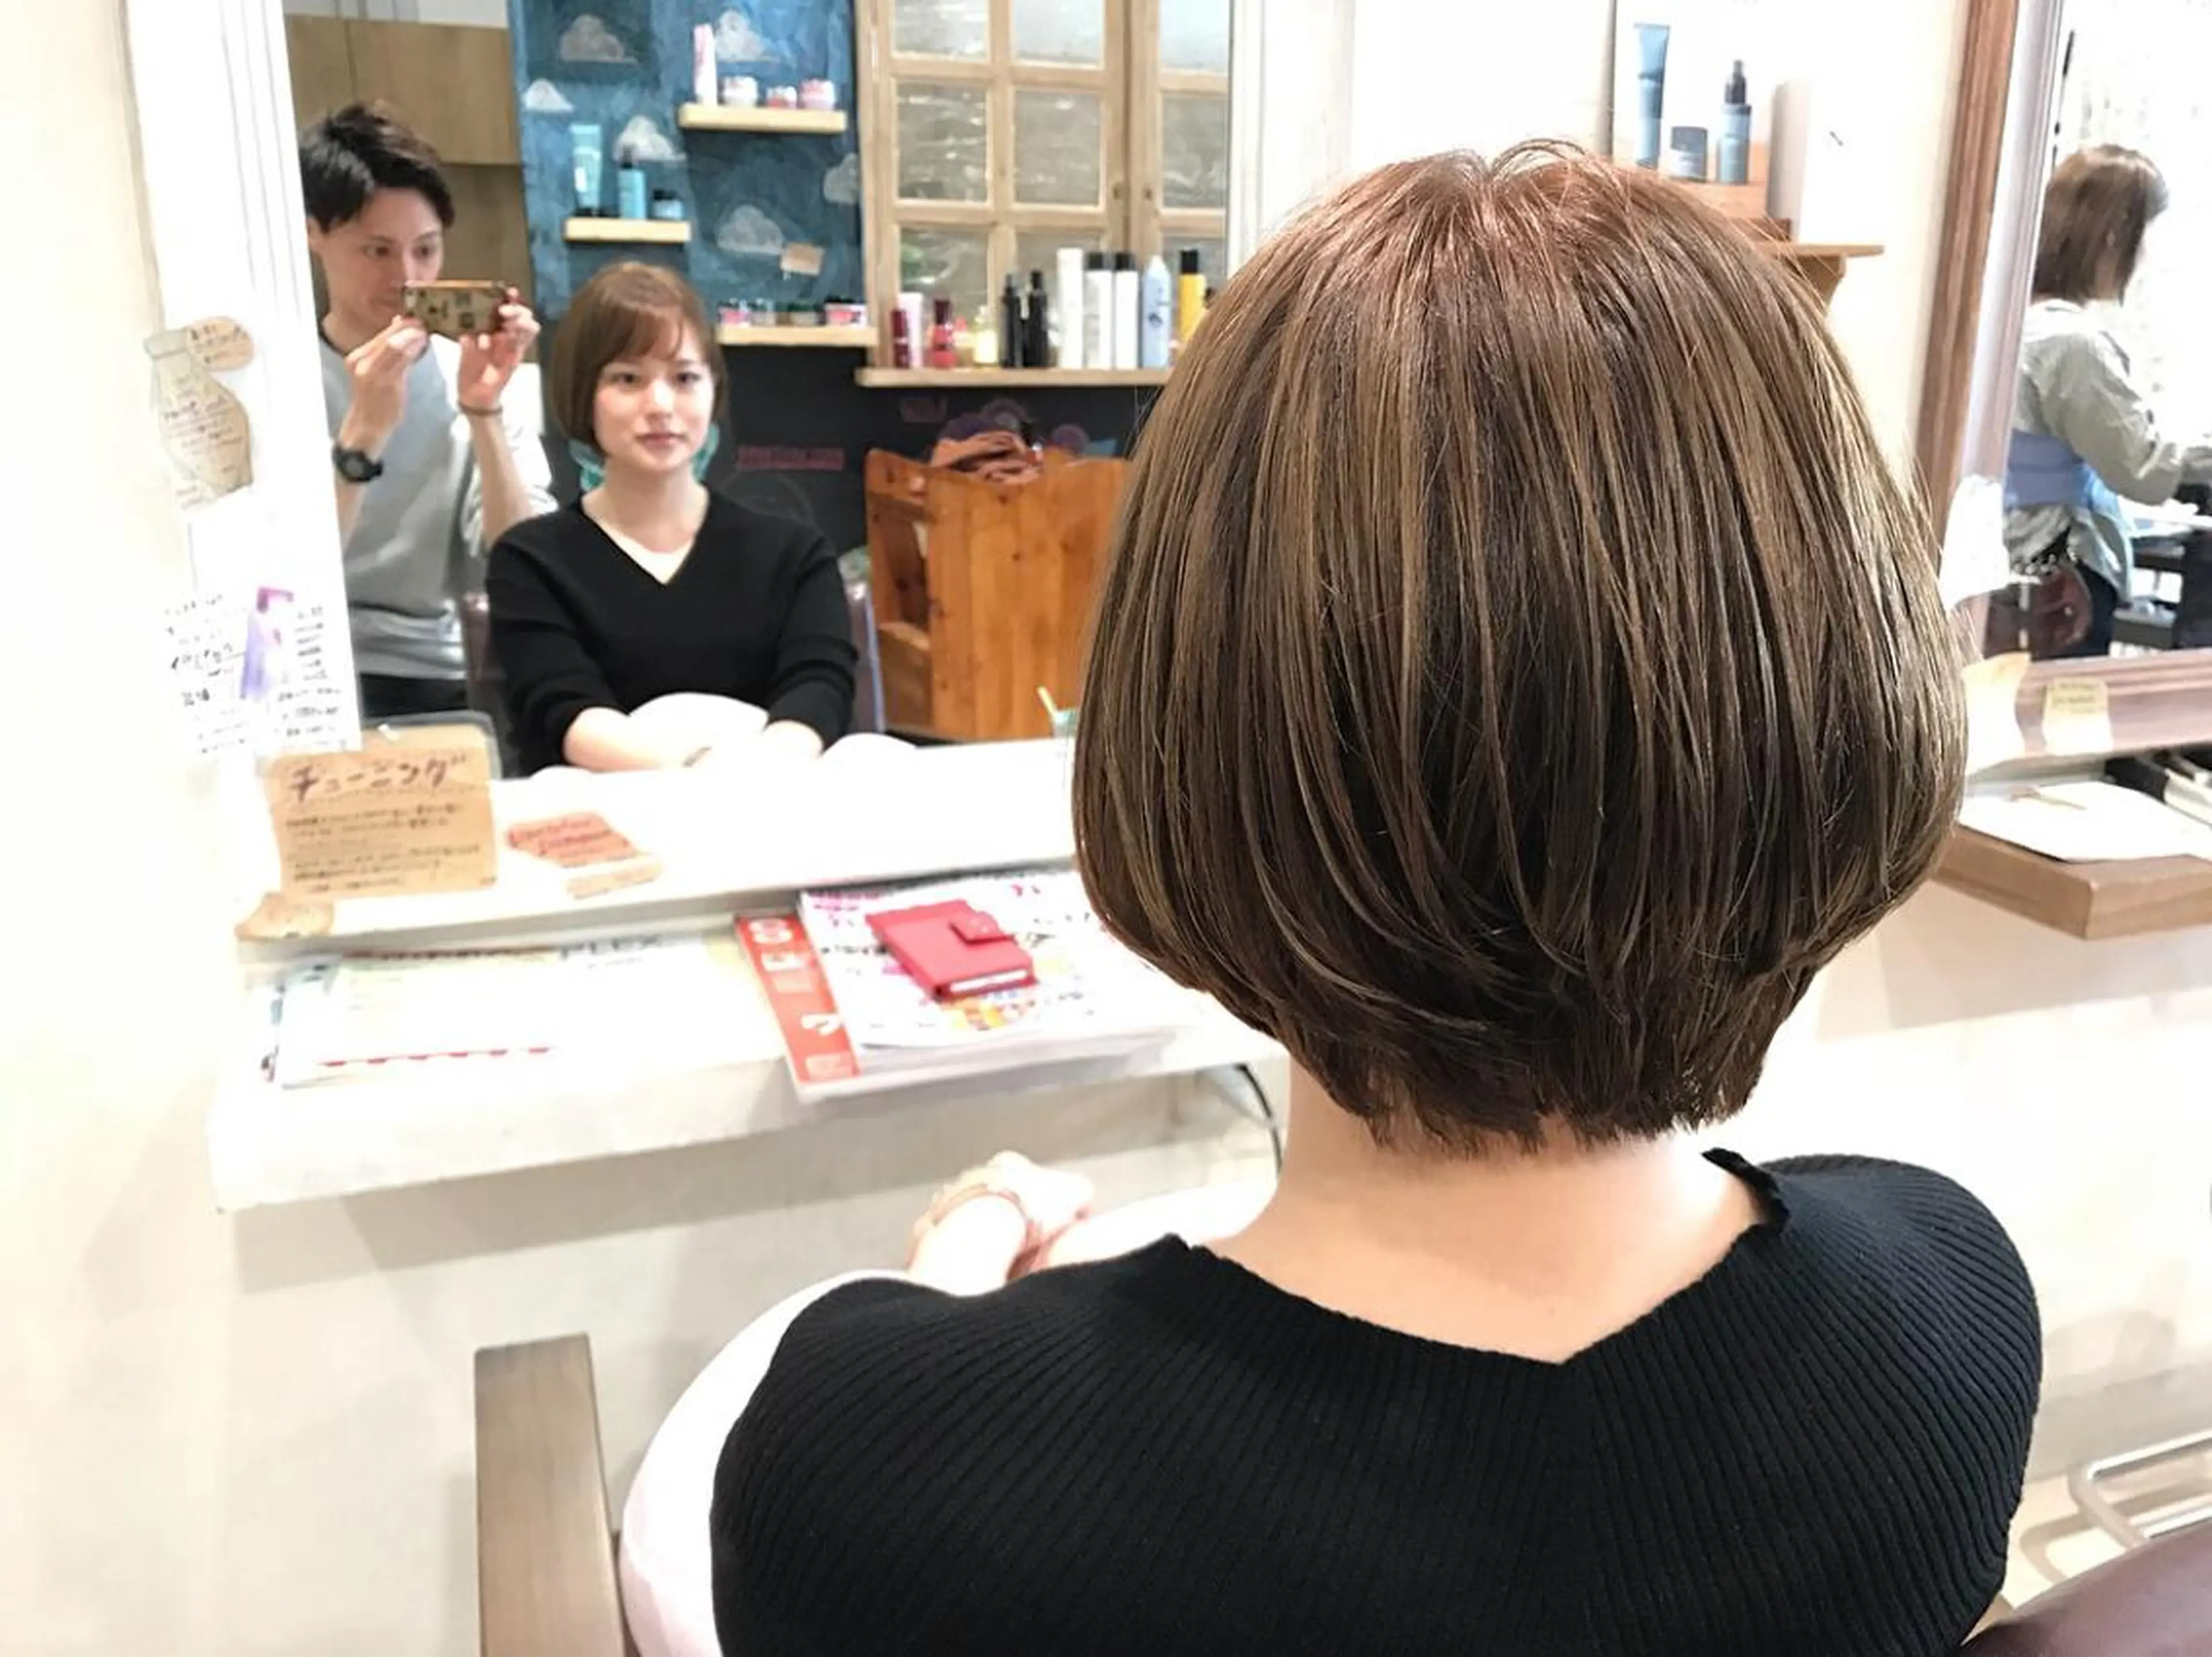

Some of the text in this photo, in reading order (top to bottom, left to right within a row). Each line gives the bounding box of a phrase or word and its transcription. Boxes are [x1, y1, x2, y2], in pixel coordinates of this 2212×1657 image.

[288, 753, 467, 802] チューニング
